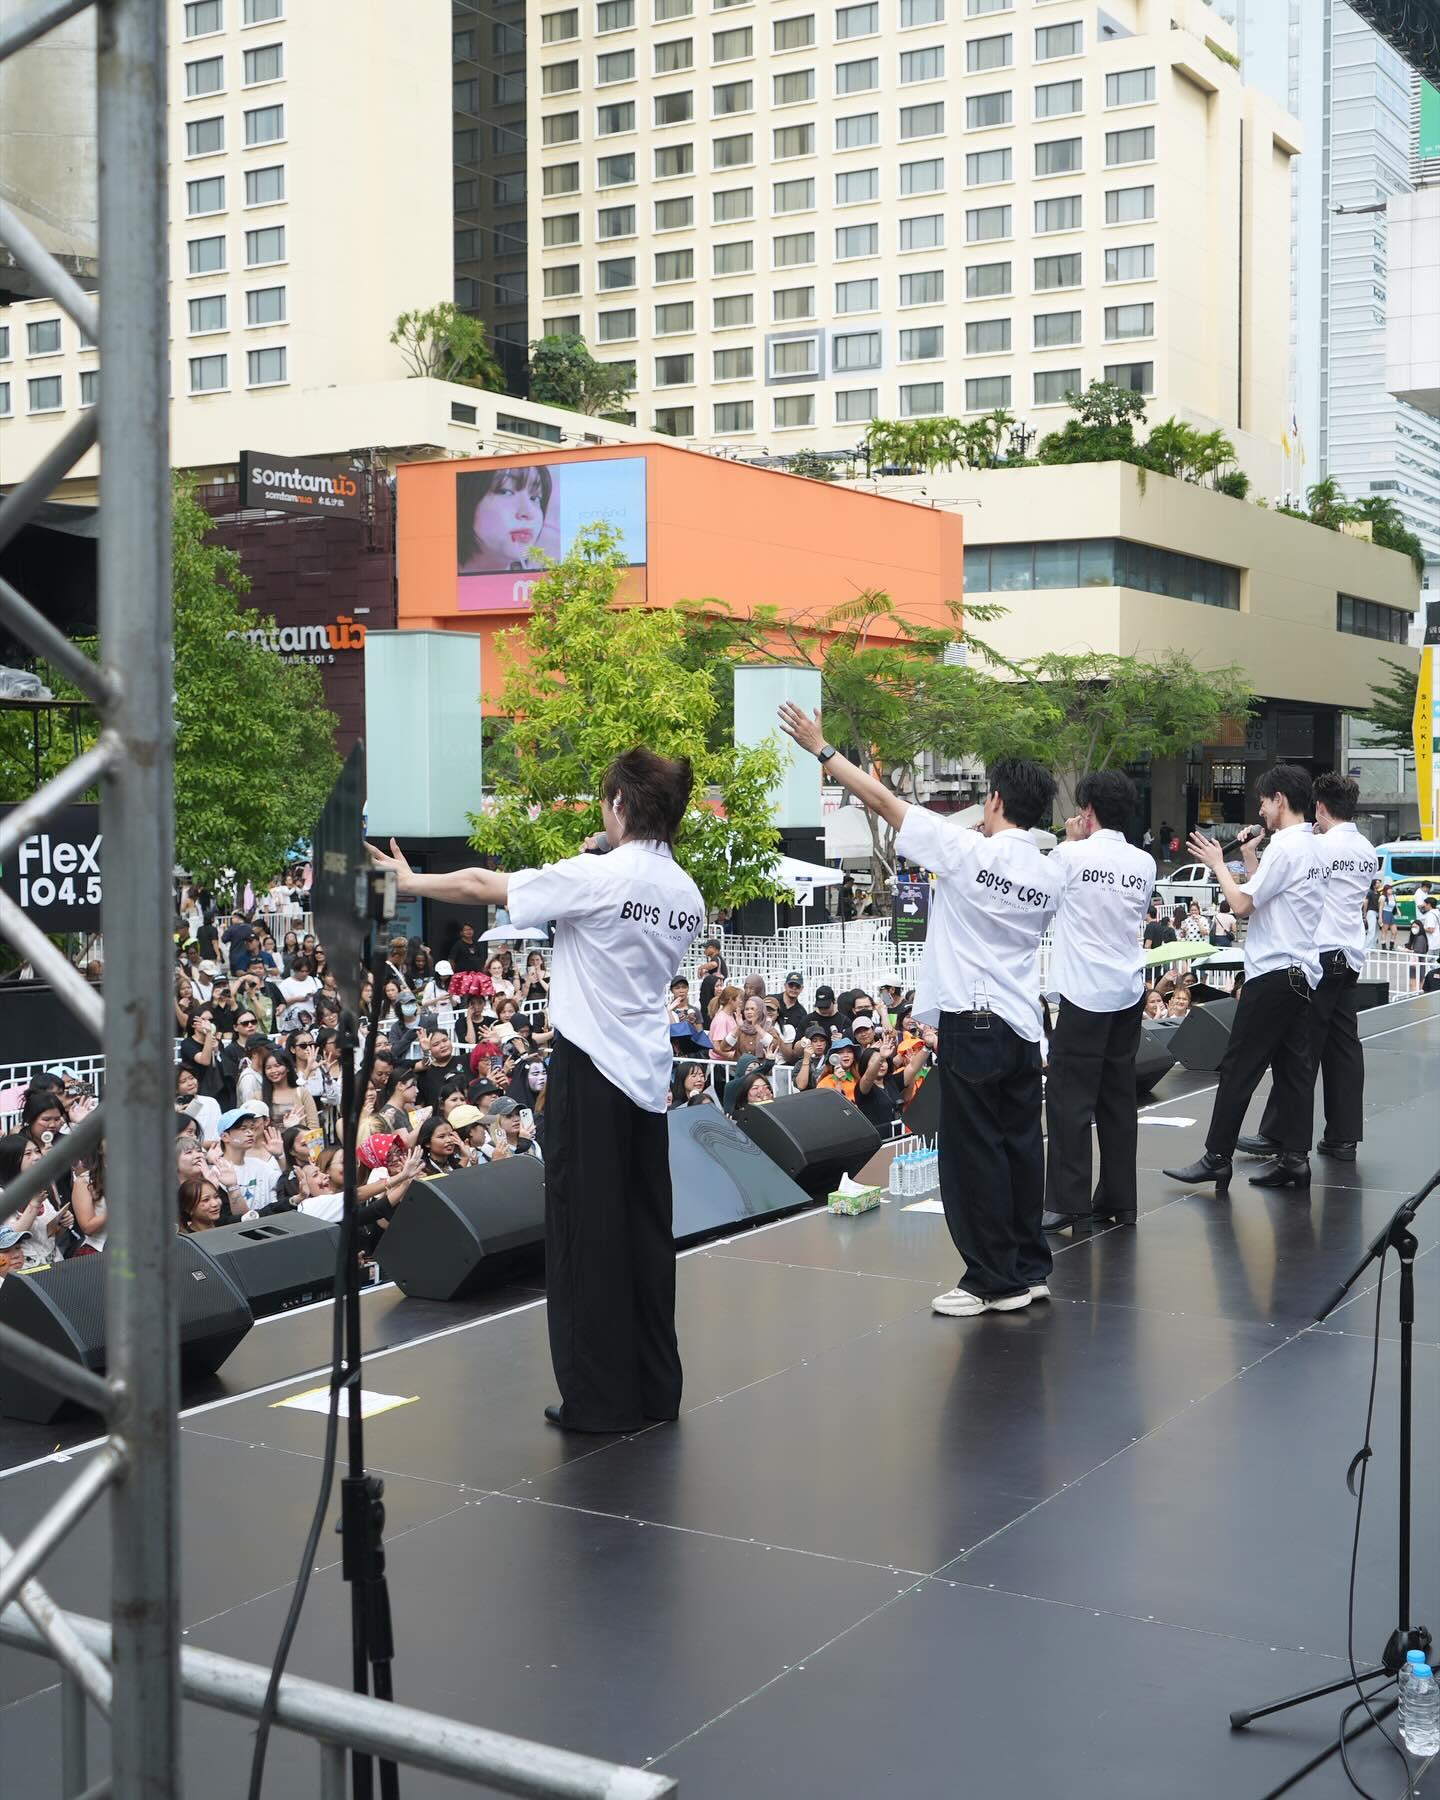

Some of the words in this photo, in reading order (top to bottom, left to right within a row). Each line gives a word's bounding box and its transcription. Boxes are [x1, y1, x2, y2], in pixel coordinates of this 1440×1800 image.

[309, 655, 325, 664] SOI
[328, 655, 335, 664] 5
[19, 834, 103, 874] Flex
[1332, 860, 1355, 872] BOYS
[20, 876, 102, 907] 104.5
[975, 869, 1012, 895] BOYS
[1017, 886, 1051, 908] LOST
[1082, 869, 1115, 885] BOYS
[1121, 874, 1147, 892] LOST
[620, 900, 660, 925] BOYS
[668, 910, 701, 933] LOST
